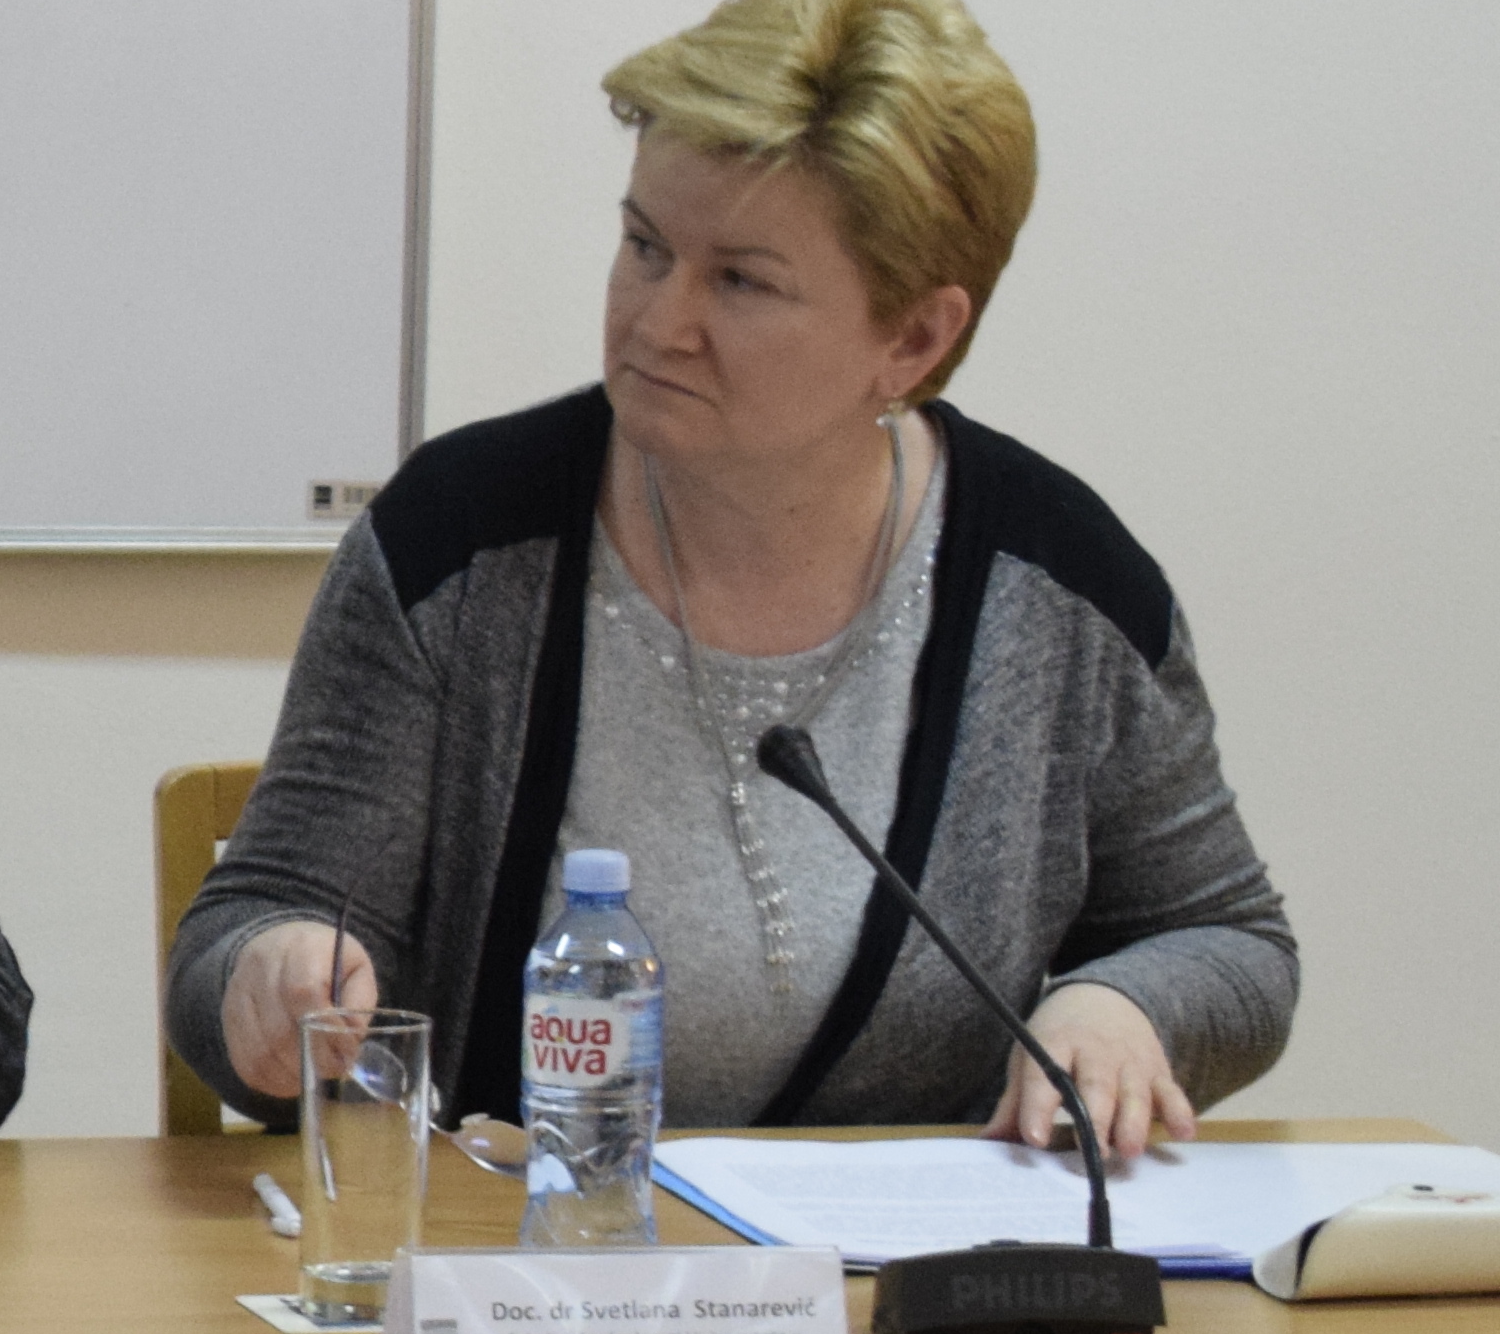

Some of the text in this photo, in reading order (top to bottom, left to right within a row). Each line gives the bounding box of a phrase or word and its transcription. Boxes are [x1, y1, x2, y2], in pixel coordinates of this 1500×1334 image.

[952, 1271, 1122, 1309] PHILIPS
[491, 1297, 816, 1321] Doc. dr Svetlana Stanarević
